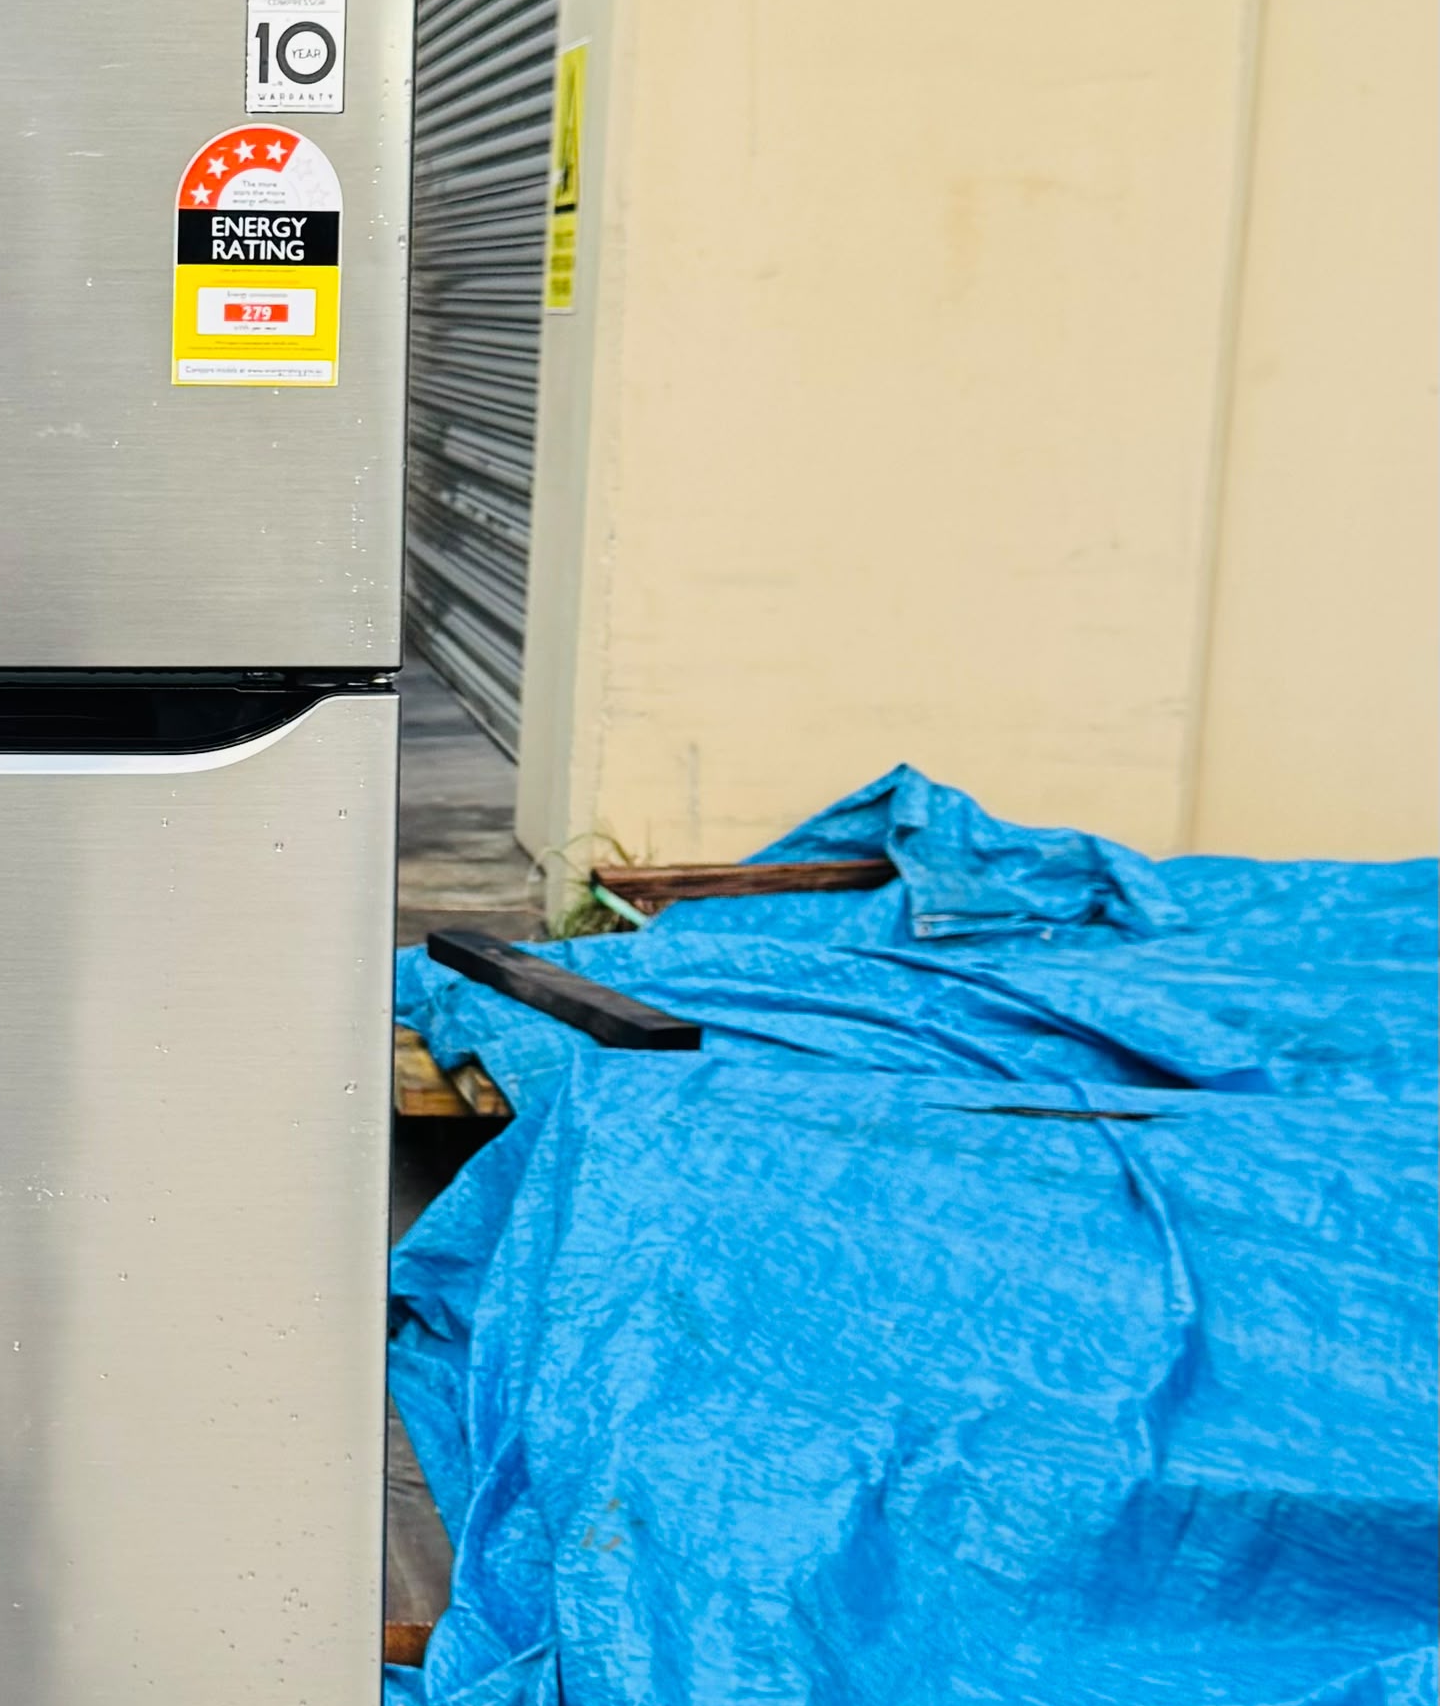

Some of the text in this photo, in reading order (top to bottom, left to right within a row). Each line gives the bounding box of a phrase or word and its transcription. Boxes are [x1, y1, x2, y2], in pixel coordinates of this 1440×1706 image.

[255, 21, 336, 85] 10 YEAR
[211, 216, 308, 238] ENERGY
[212, 239, 305, 261] RATING
[242, 305, 273, 321] 279
